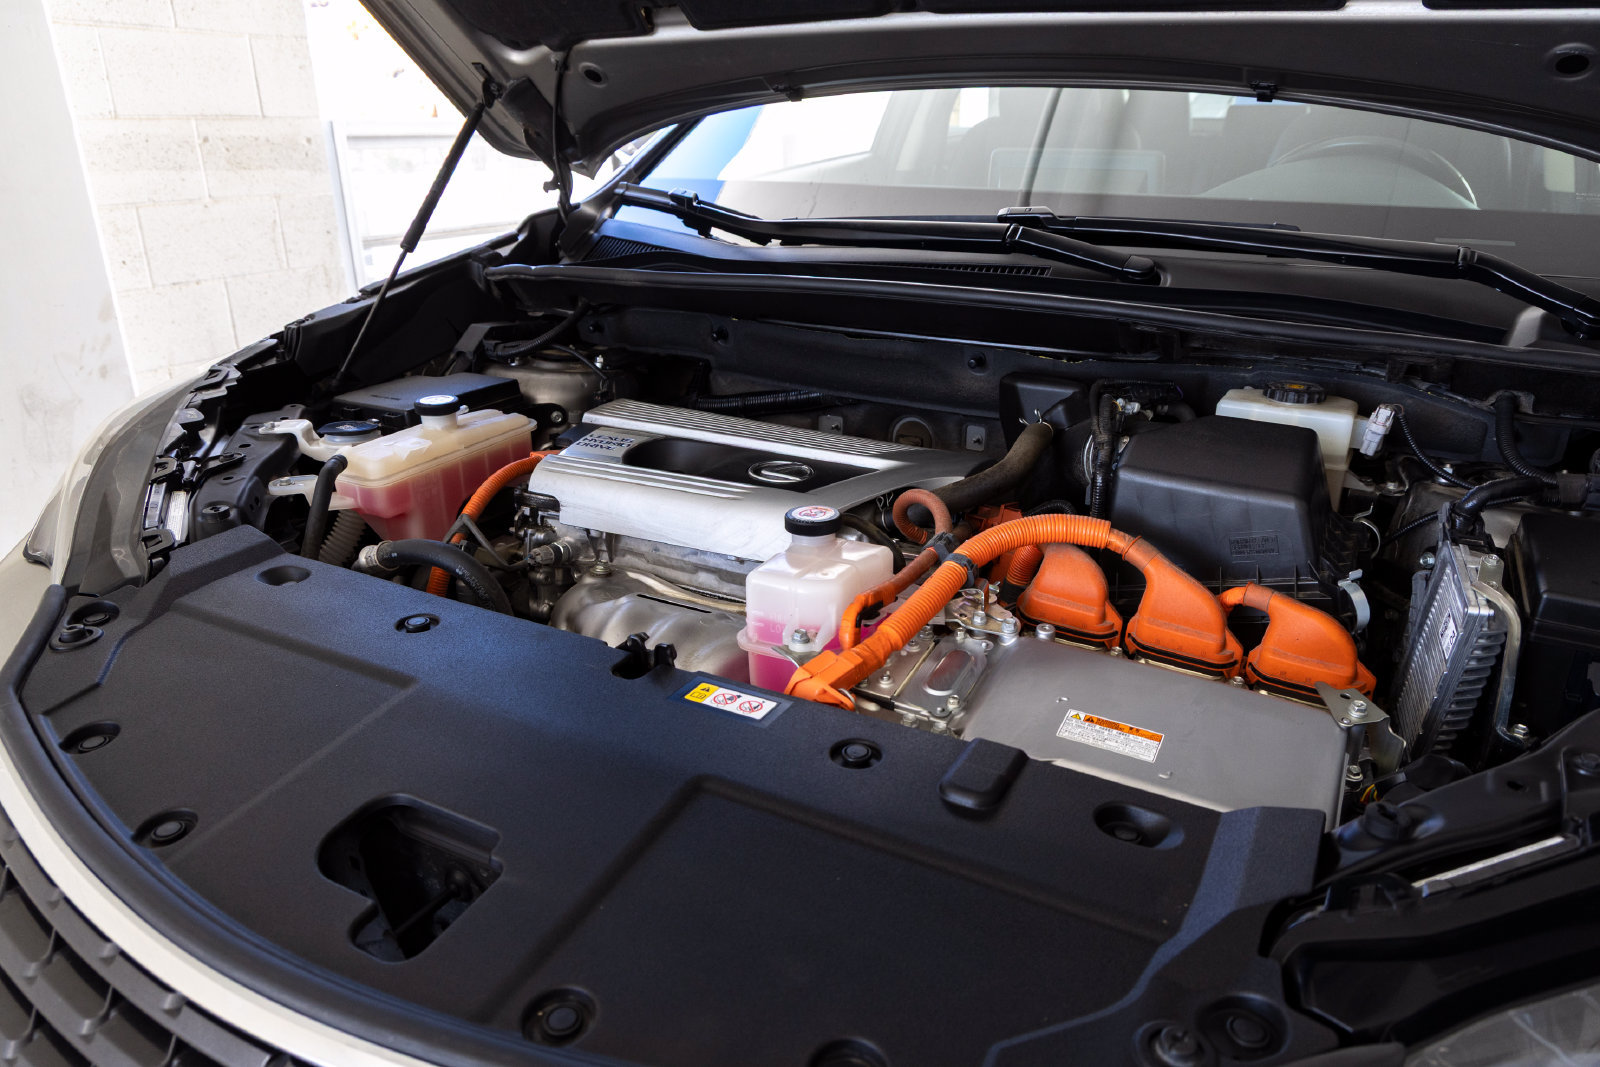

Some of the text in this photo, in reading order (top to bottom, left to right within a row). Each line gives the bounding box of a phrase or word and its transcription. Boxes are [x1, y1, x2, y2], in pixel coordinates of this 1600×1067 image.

[589, 434, 634, 442] LEXUS
[576, 442, 615, 450] DRIVE
[583, 438, 631, 447] HYBRID
